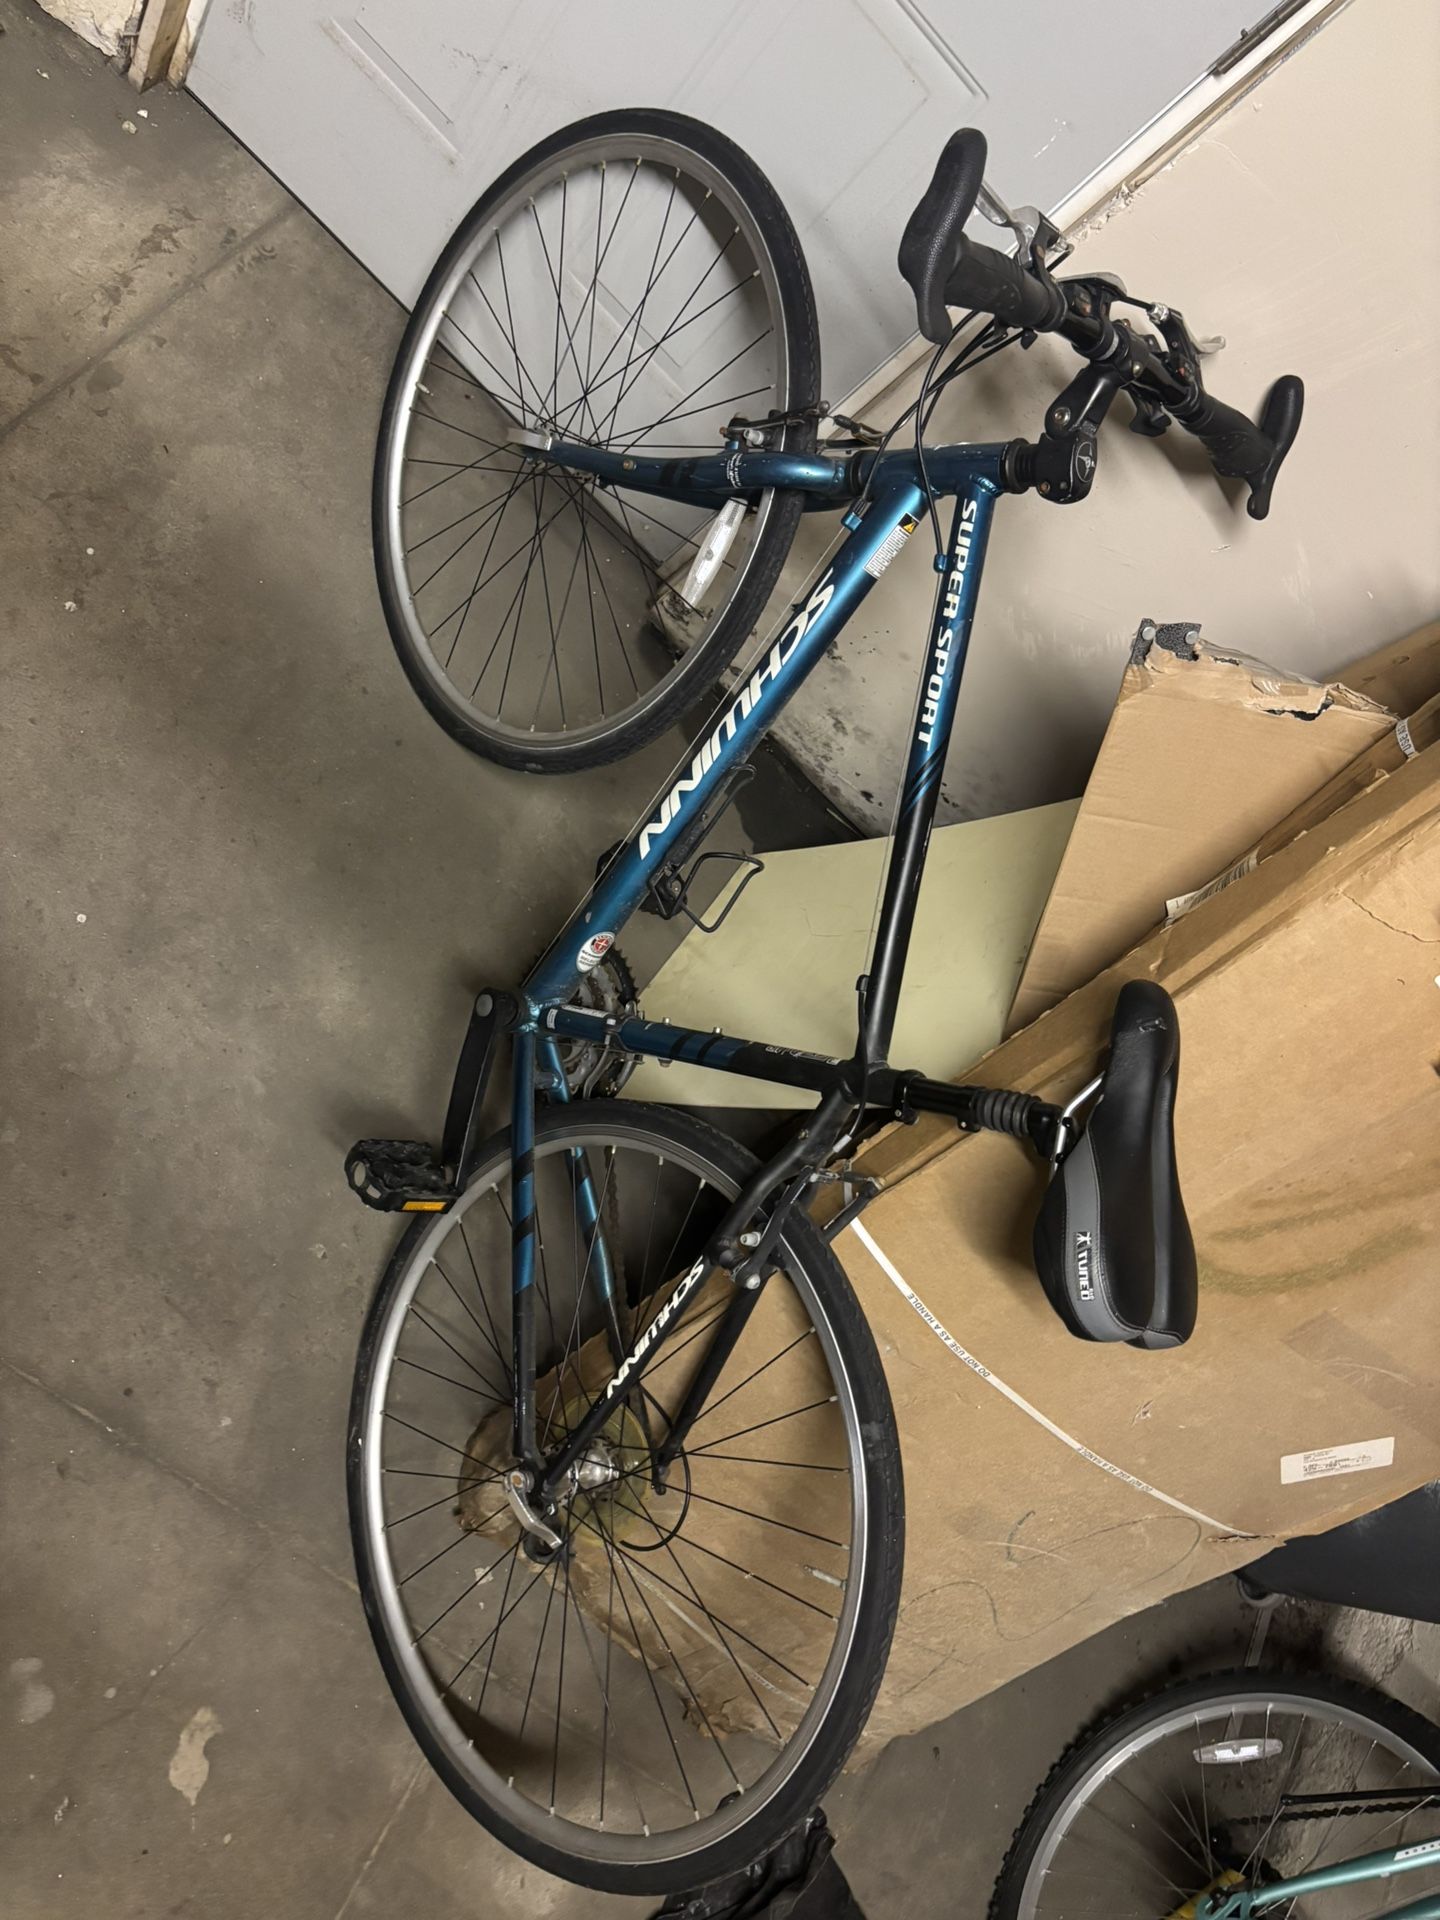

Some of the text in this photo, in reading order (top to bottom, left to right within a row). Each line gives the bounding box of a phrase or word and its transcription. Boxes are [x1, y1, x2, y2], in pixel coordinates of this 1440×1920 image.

[918, 498, 978, 751] SUPER SPORT
[638, 567, 835, 861] SCHWINN
[906, 1292, 936, 1324] HANDLE
[606, 1254, 705, 1400] SCHWINN
[939, 1330, 951, 1341] AS
[949, 1341, 965, 1356] USE
[963, 1355, 980, 1369] NOT
[978, 1367, 991, 1378] DO
